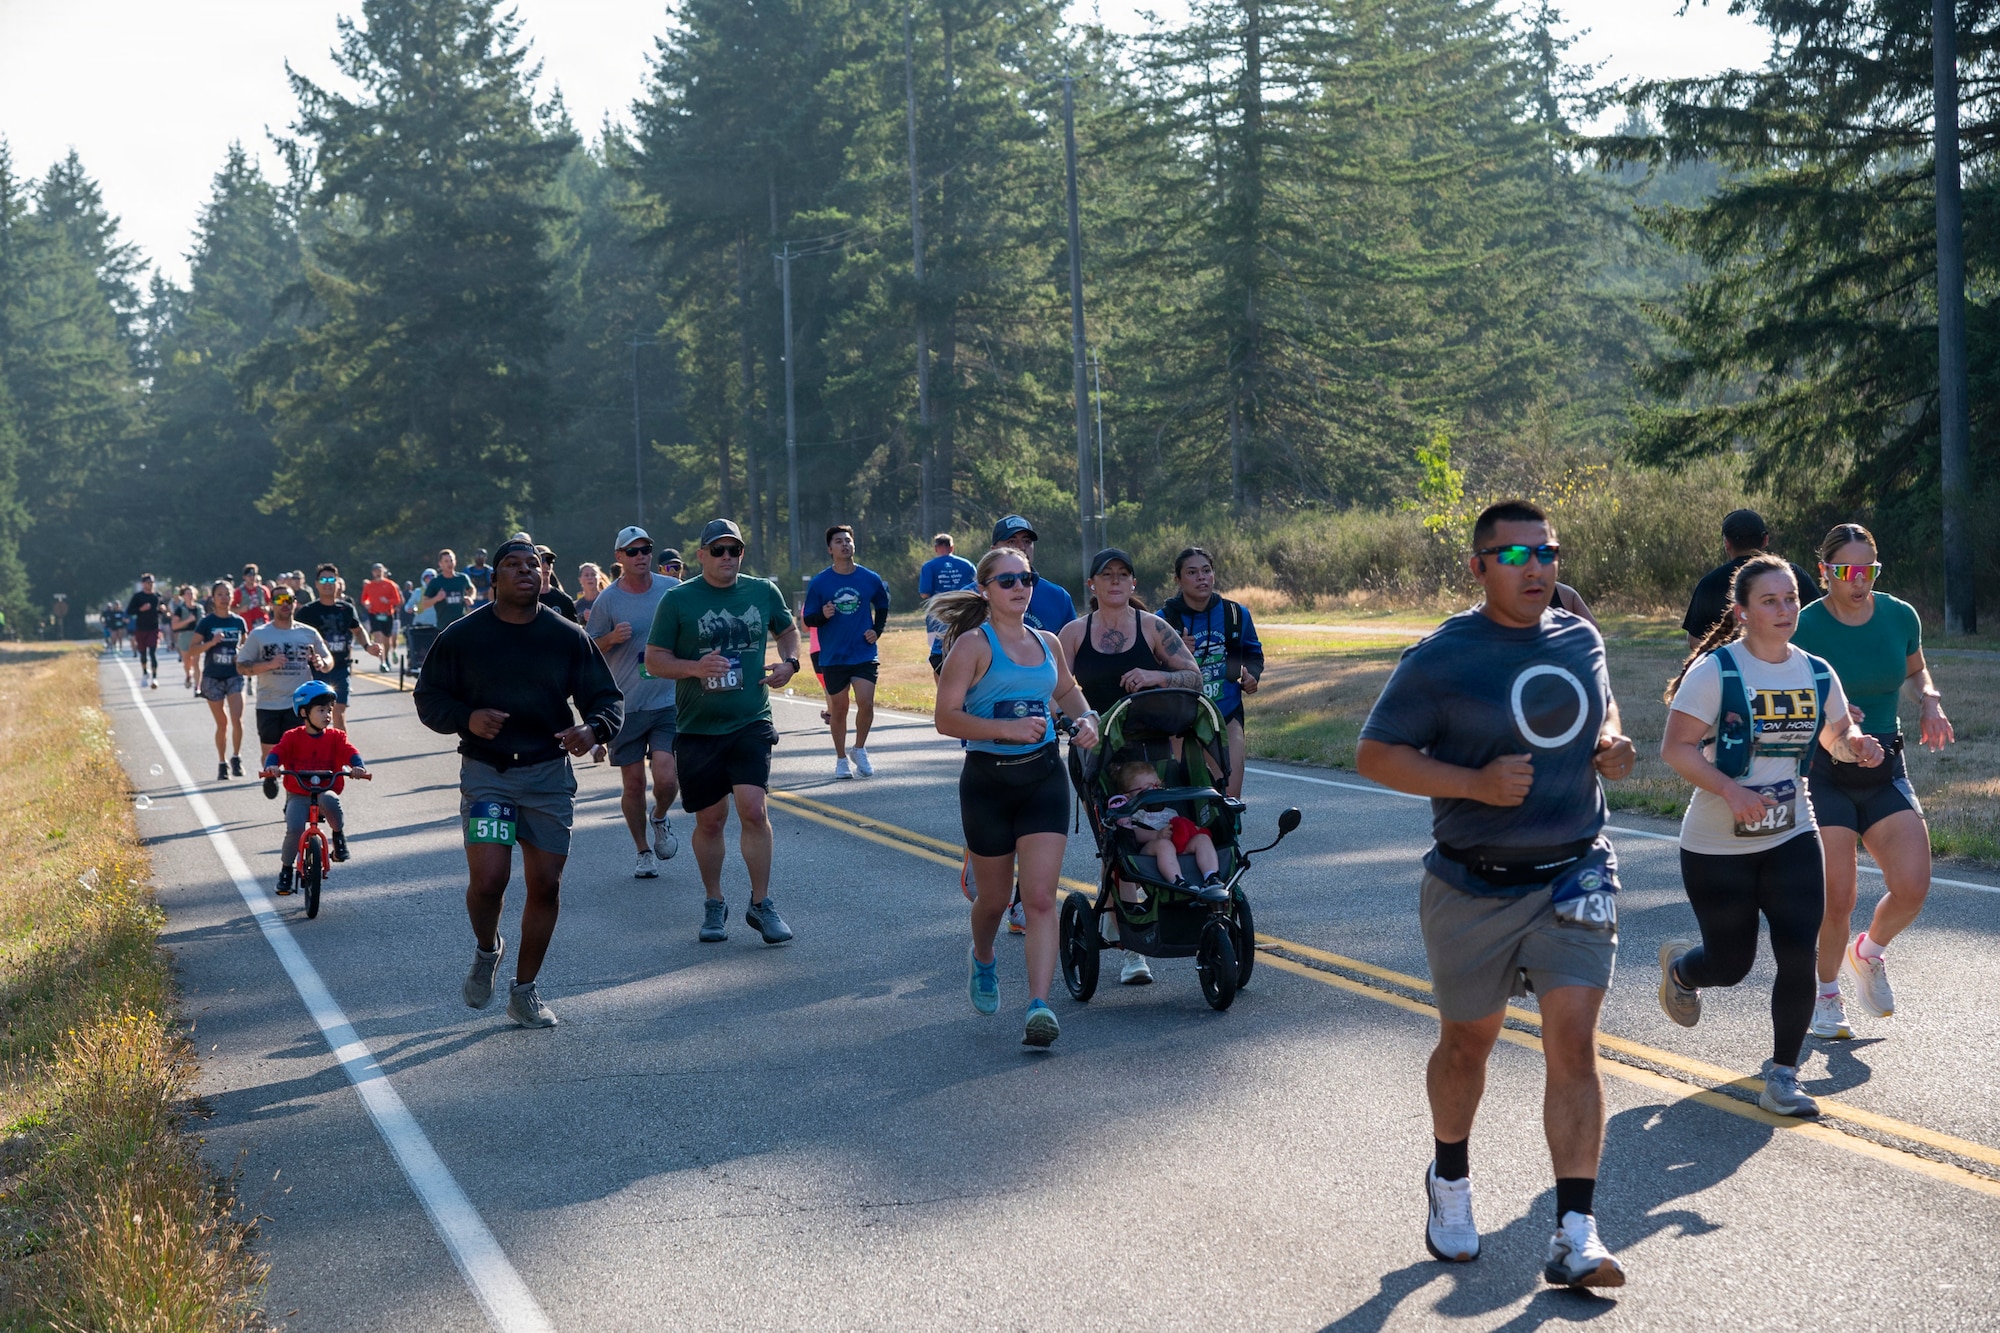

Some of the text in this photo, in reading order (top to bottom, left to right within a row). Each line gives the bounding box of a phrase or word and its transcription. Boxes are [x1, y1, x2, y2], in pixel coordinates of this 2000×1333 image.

[217, 653, 232, 664] 761
[707, 671, 738, 689] 816
[1203, 682, 1220, 698] 98
[1786, 721, 1815, 729] HORS
[503, 807, 511, 816] 5K
[477, 820, 509, 840] 515
[1569, 893, 1617, 924] 730
